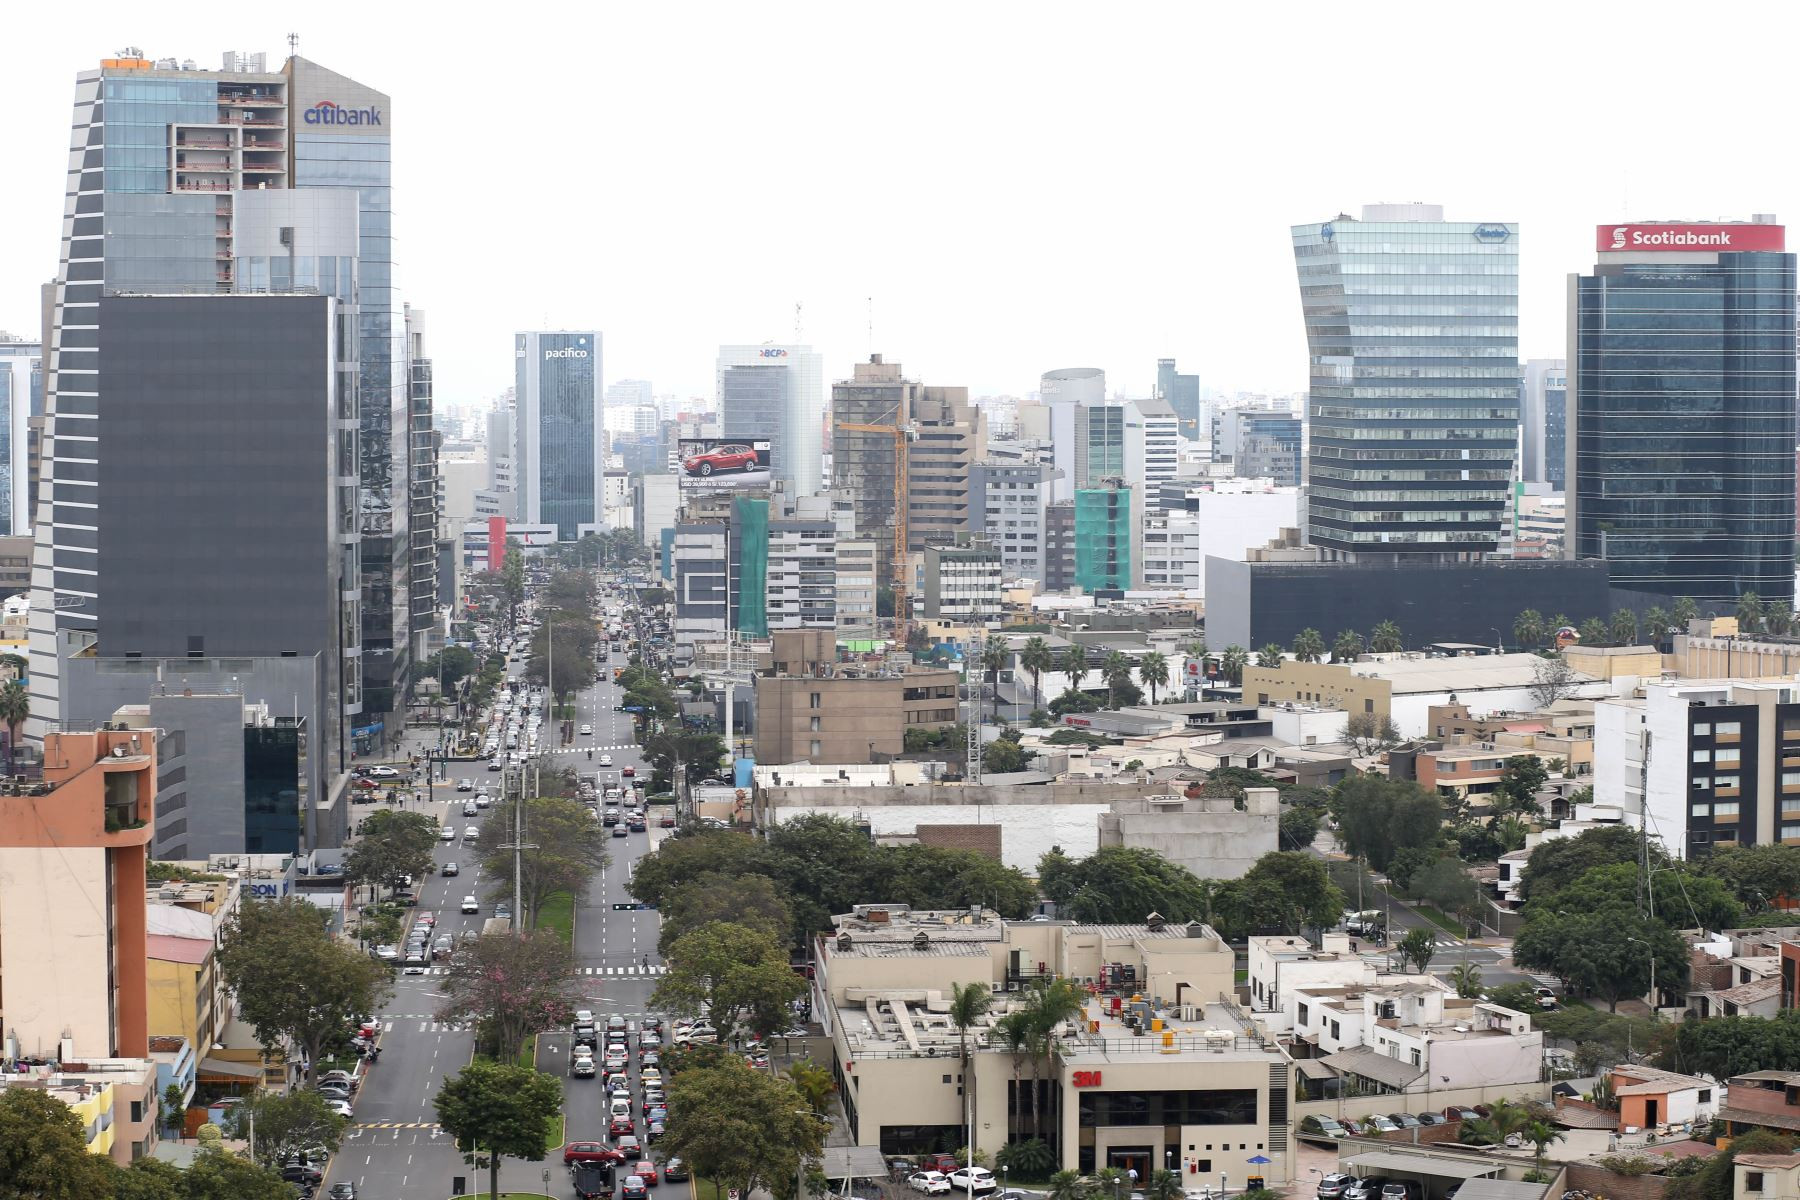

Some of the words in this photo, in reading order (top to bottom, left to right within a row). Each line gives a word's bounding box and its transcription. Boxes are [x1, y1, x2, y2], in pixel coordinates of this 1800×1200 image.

[304, 104, 381, 126] citibank
[1633, 231, 1732, 245] Scotiabank
[764, 349, 782, 358] BCP
[1072, 1070, 1102, 1088] 3M
